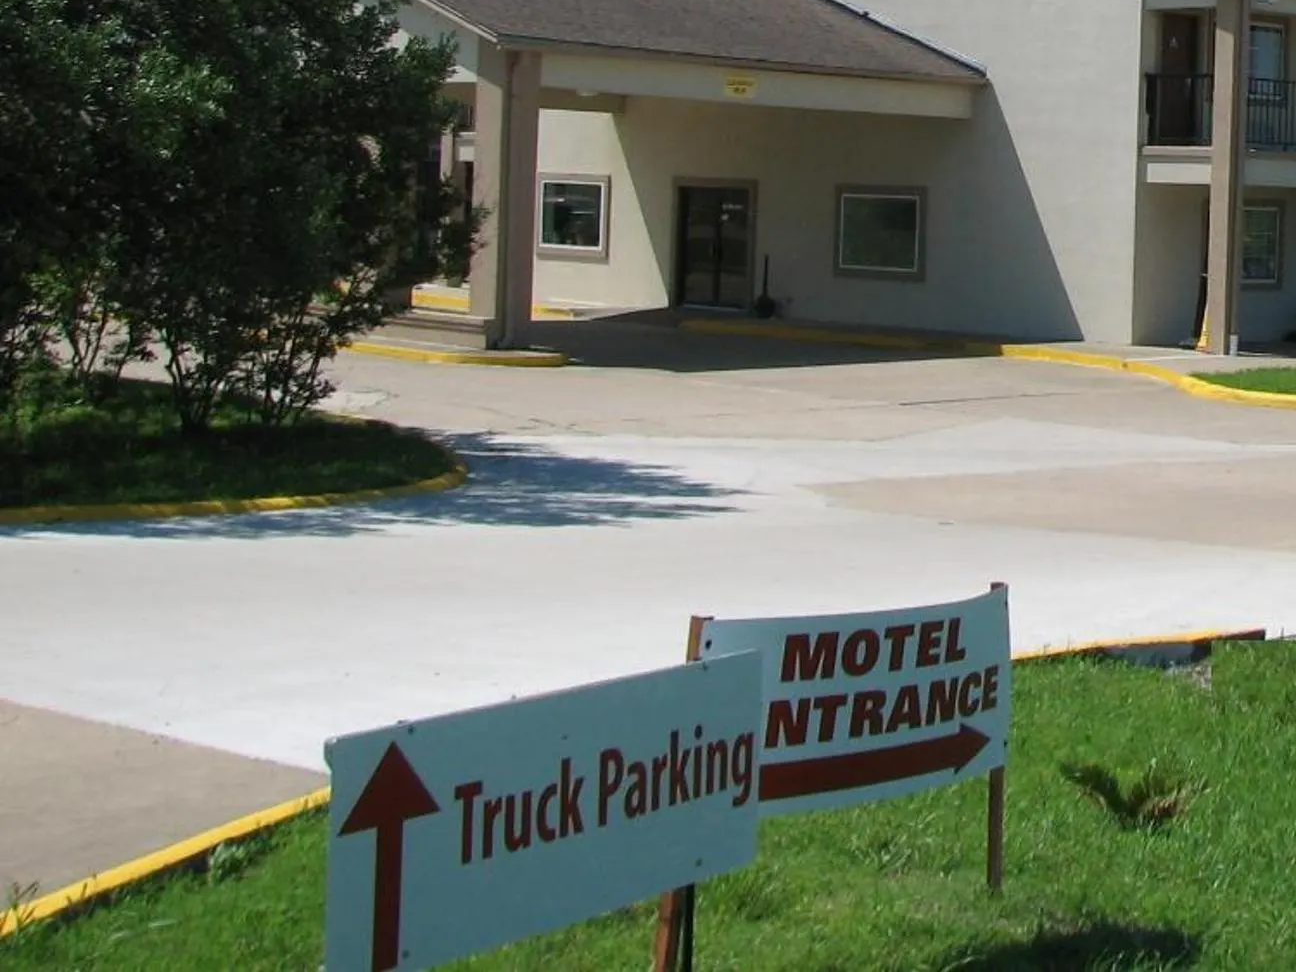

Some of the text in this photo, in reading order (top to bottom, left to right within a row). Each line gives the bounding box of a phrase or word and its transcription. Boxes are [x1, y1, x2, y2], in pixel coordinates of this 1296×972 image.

[780, 617, 967, 683] MOTEL
[764, 665, 999, 748] NTRANCE
[454, 724, 754, 865] Truck Parking
